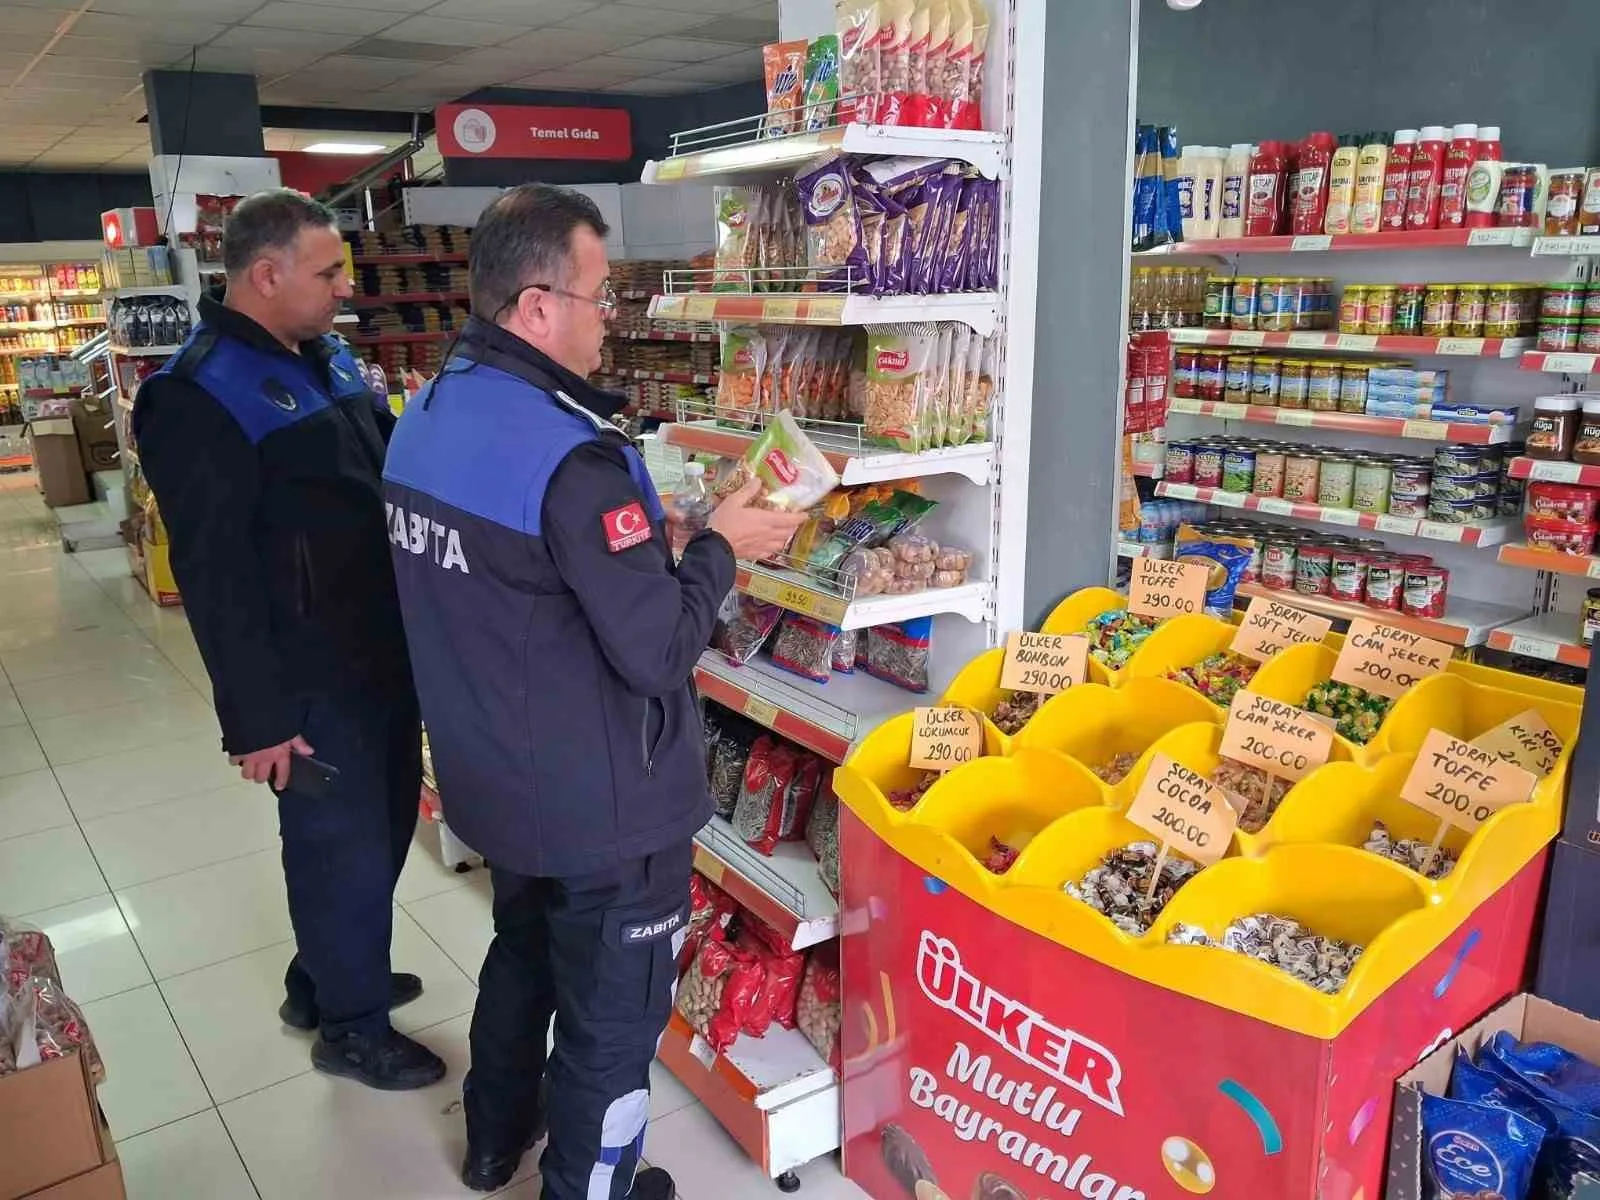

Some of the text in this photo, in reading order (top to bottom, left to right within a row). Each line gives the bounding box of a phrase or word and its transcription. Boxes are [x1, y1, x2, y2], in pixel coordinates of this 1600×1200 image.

[530, 126, 568, 139] Temel
[1584, 427, 1600, 438] nug
[1143, 559, 1185, 577] ÜLKER
[1139, 574, 1178, 589] TOFFE
[1142, 592, 1194, 613] 290.00
[1249, 614, 1282, 633] SOFT
[1020, 633, 1062, 649] ÜLKER
[1351, 634, 1384, 653] CAM
[1015, 650, 1070, 667] BONBON
[1020, 670, 1072, 690] 290.00
[1235, 710, 1269, 726] CAM
[924, 744, 972, 763] 290.00
[1241, 737, 1307, 770] 200.00
[1431, 752, 1498, 791] TOFFE
[1156, 777, 1213, 815] COCOA
[1425, 782, 1496, 822] 200.0
[1151, 807, 1211, 848] 200.00
[630, 914, 680, 939] ZABITA
[915, 929, 1126, 1118] ÜLKER
[945, 1041, 1083, 1137] Mutlu
